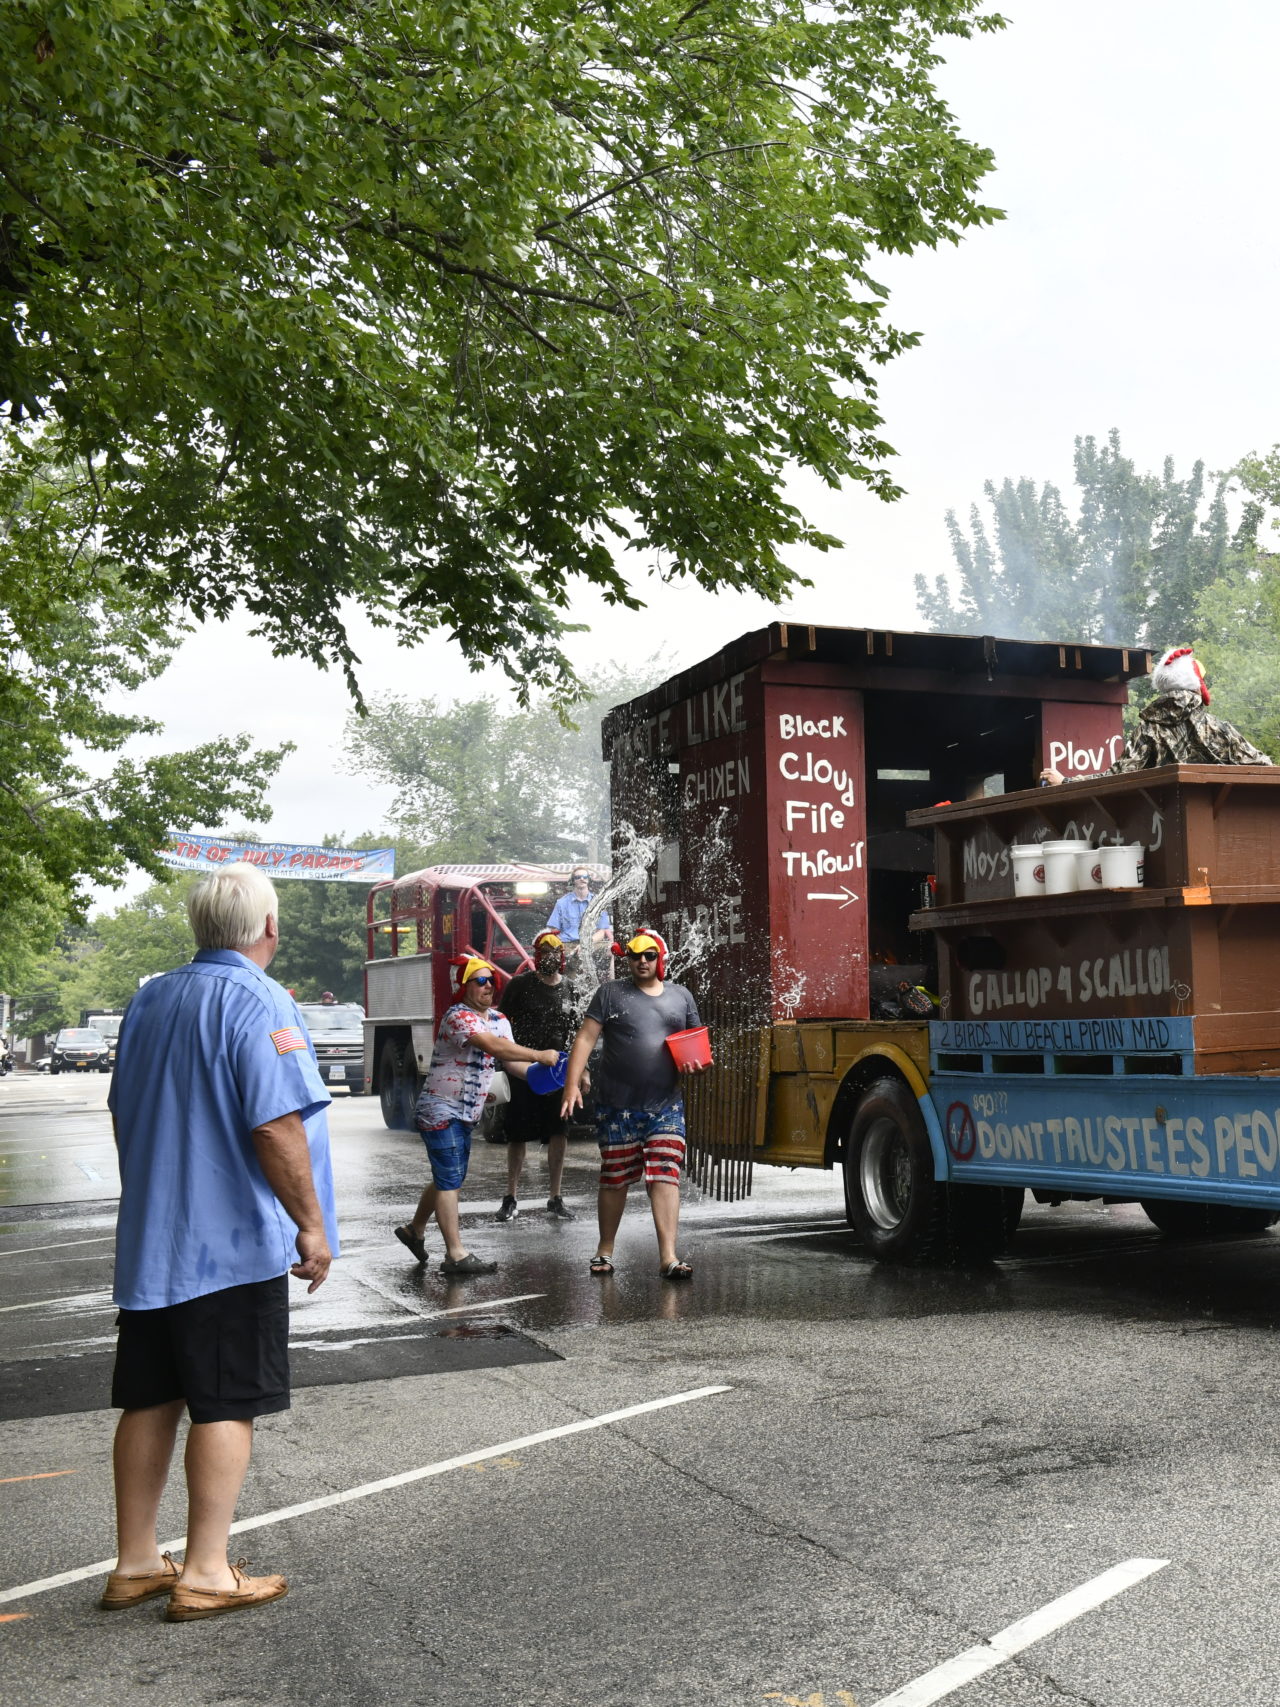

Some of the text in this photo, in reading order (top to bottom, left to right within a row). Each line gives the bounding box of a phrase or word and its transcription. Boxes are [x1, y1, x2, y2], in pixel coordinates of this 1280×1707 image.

[687, 673, 747, 746] LIKE
[779, 714, 848, 740] Black
[685, 756, 750, 806] CHIKEN
[779, 752, 855, 807] Cloud
[786, 800, 845, 834] Fire
[200, 838, 247, 848] COMBINED
[250, 843, 293, 852] VETERANS
[295, 847, 358, 856] ORGANIZATION
[206, 846, 233, 863] OF
[289, 853, 366, 871] PARADE
[964, 834, 1018, 884] Moys
[309, 872, 345, 880] SQUARE
[969, 966, 1053, 1016] GALLOP
[940, 1022, 951, 1047] 2
[1000, 1021, 1020, 1049] NO
[1132, 1018, 1170, 1049] MAD
